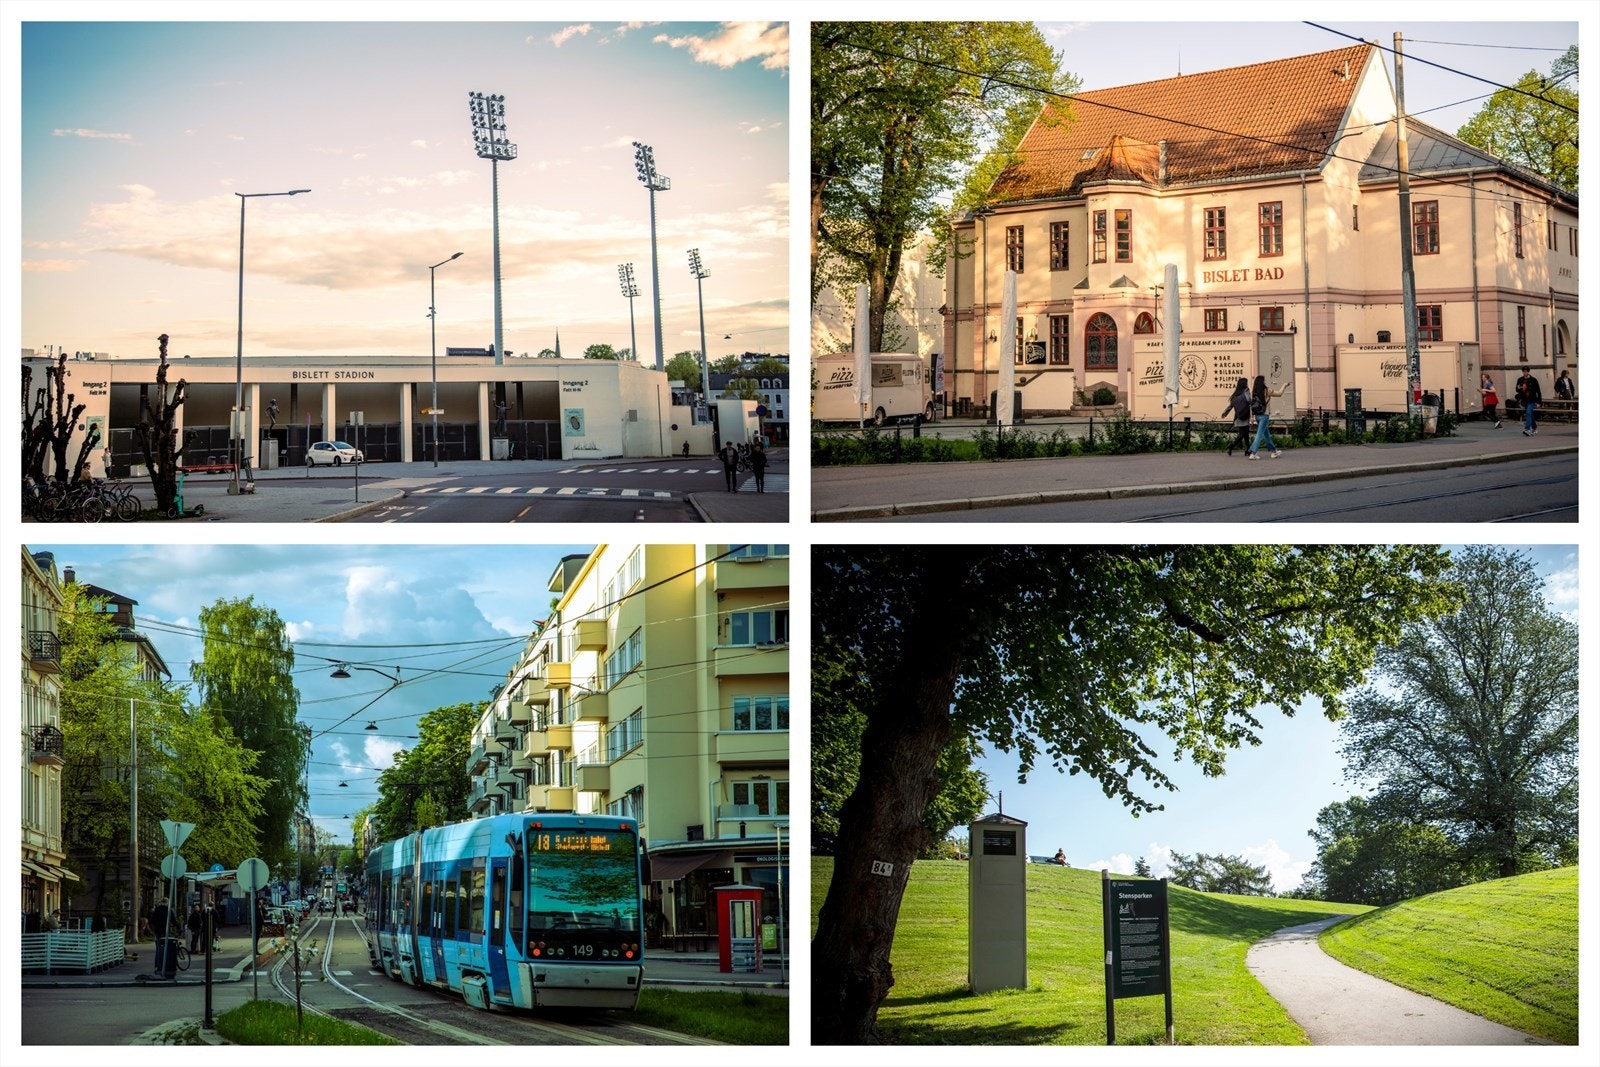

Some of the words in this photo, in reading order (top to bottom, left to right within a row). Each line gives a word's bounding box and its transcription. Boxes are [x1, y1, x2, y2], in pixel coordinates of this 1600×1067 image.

[1203, 269, 1249, 283] BISLET
[1255, 266, 1284, 281] BAD
[292, 371, 329, 379] BISLETT
[334, 371, 375, 379] STADION
[1145, 366, 1164, 376] PIZZ
[1118, 892, 1153, 900] Stensparken
[572, 944, 594, 956] 149
